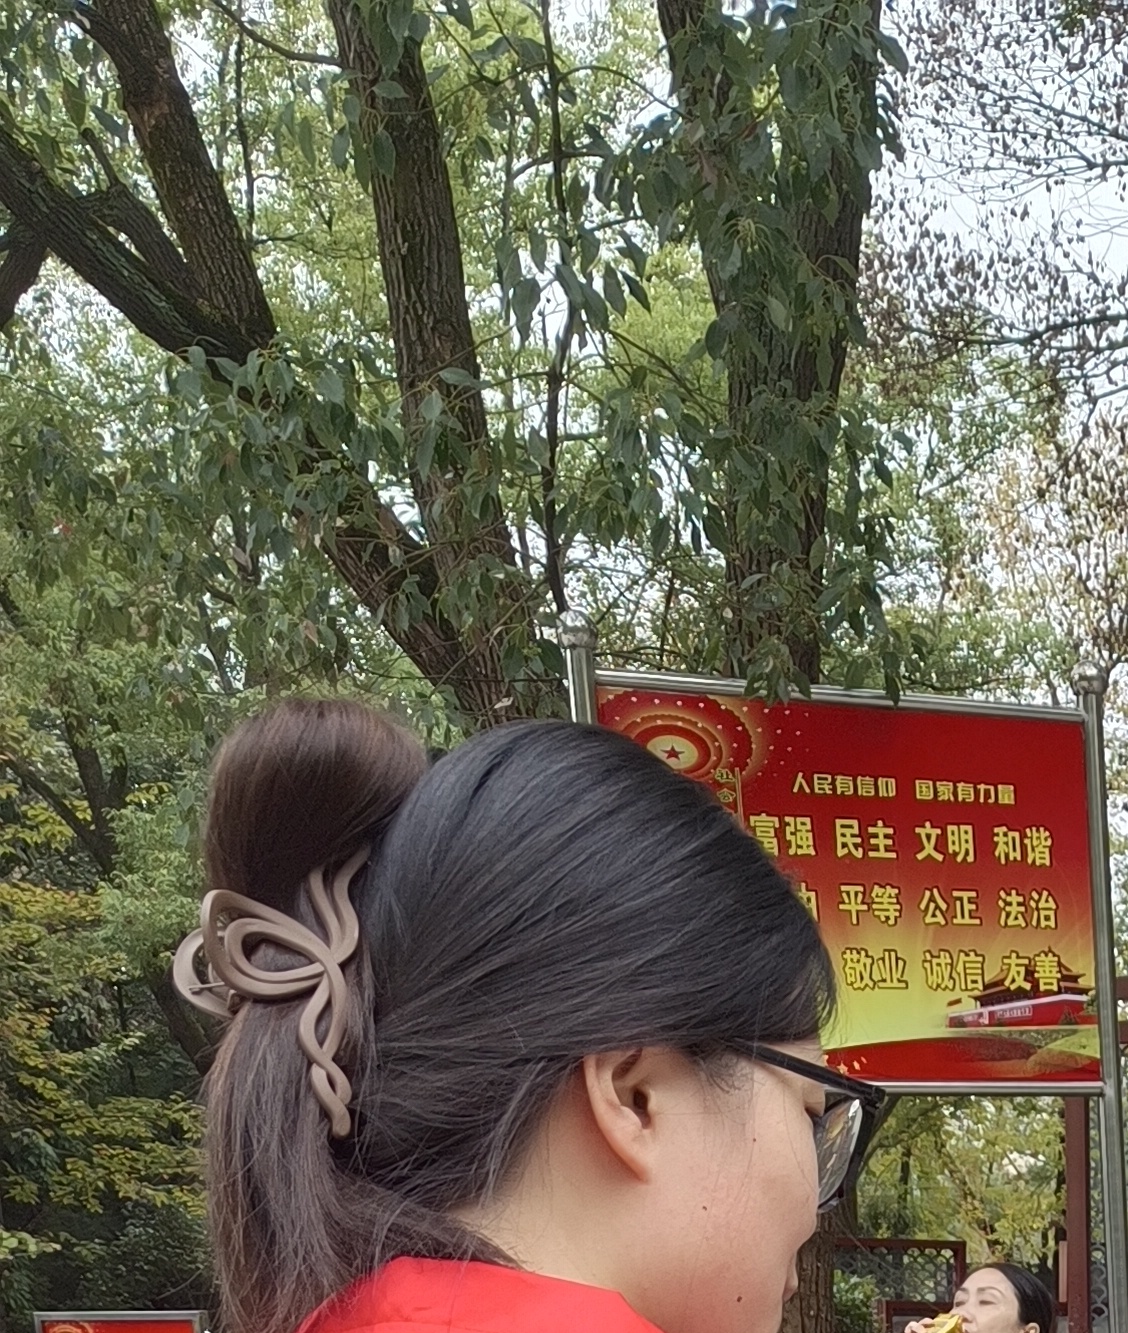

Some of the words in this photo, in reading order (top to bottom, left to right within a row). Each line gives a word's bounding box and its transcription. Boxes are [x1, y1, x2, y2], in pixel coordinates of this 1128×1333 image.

[792, 771, 897, 798] 人民有信仰
[914, 778, 1016, 805] 国家有力量
[749, 812, 817, 857] 富强
[835, 818, 898, 859] 民主
[914, 820, 976, 863] 文明
[993, 825, 1053, 867] 和谐
[838, 883, 902, 926] 平等
[918, 886, 982, 926] 公正
[997, 888, 1058, 930] 法治
[842, 947, 909, 992] 敬业
[922, 949, 985, 992] 诚信
[1001, 951, 1062, 993] 友善
